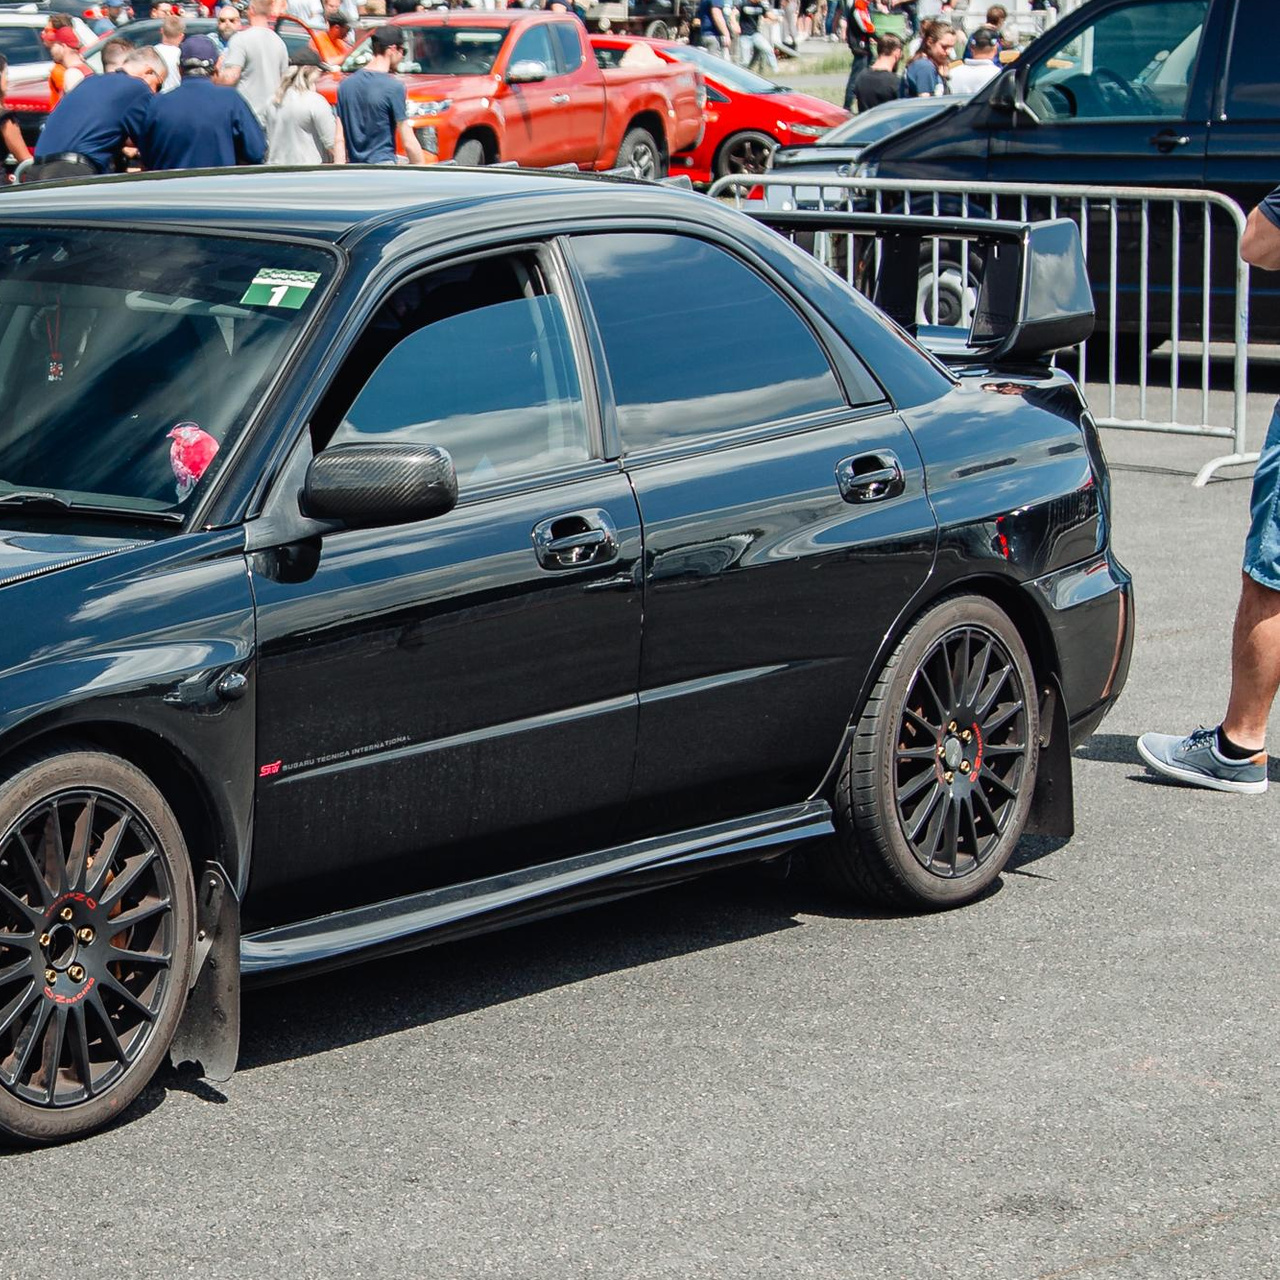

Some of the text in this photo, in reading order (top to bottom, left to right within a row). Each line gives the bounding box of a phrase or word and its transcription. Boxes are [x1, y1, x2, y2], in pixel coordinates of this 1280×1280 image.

[268, 285, 289, 307] 1
[282, 759, 315, 771] SUBARU
[317, 750, 350, 763] TECNICA
[351, 734, 412, 755] INTERNATIONAL
